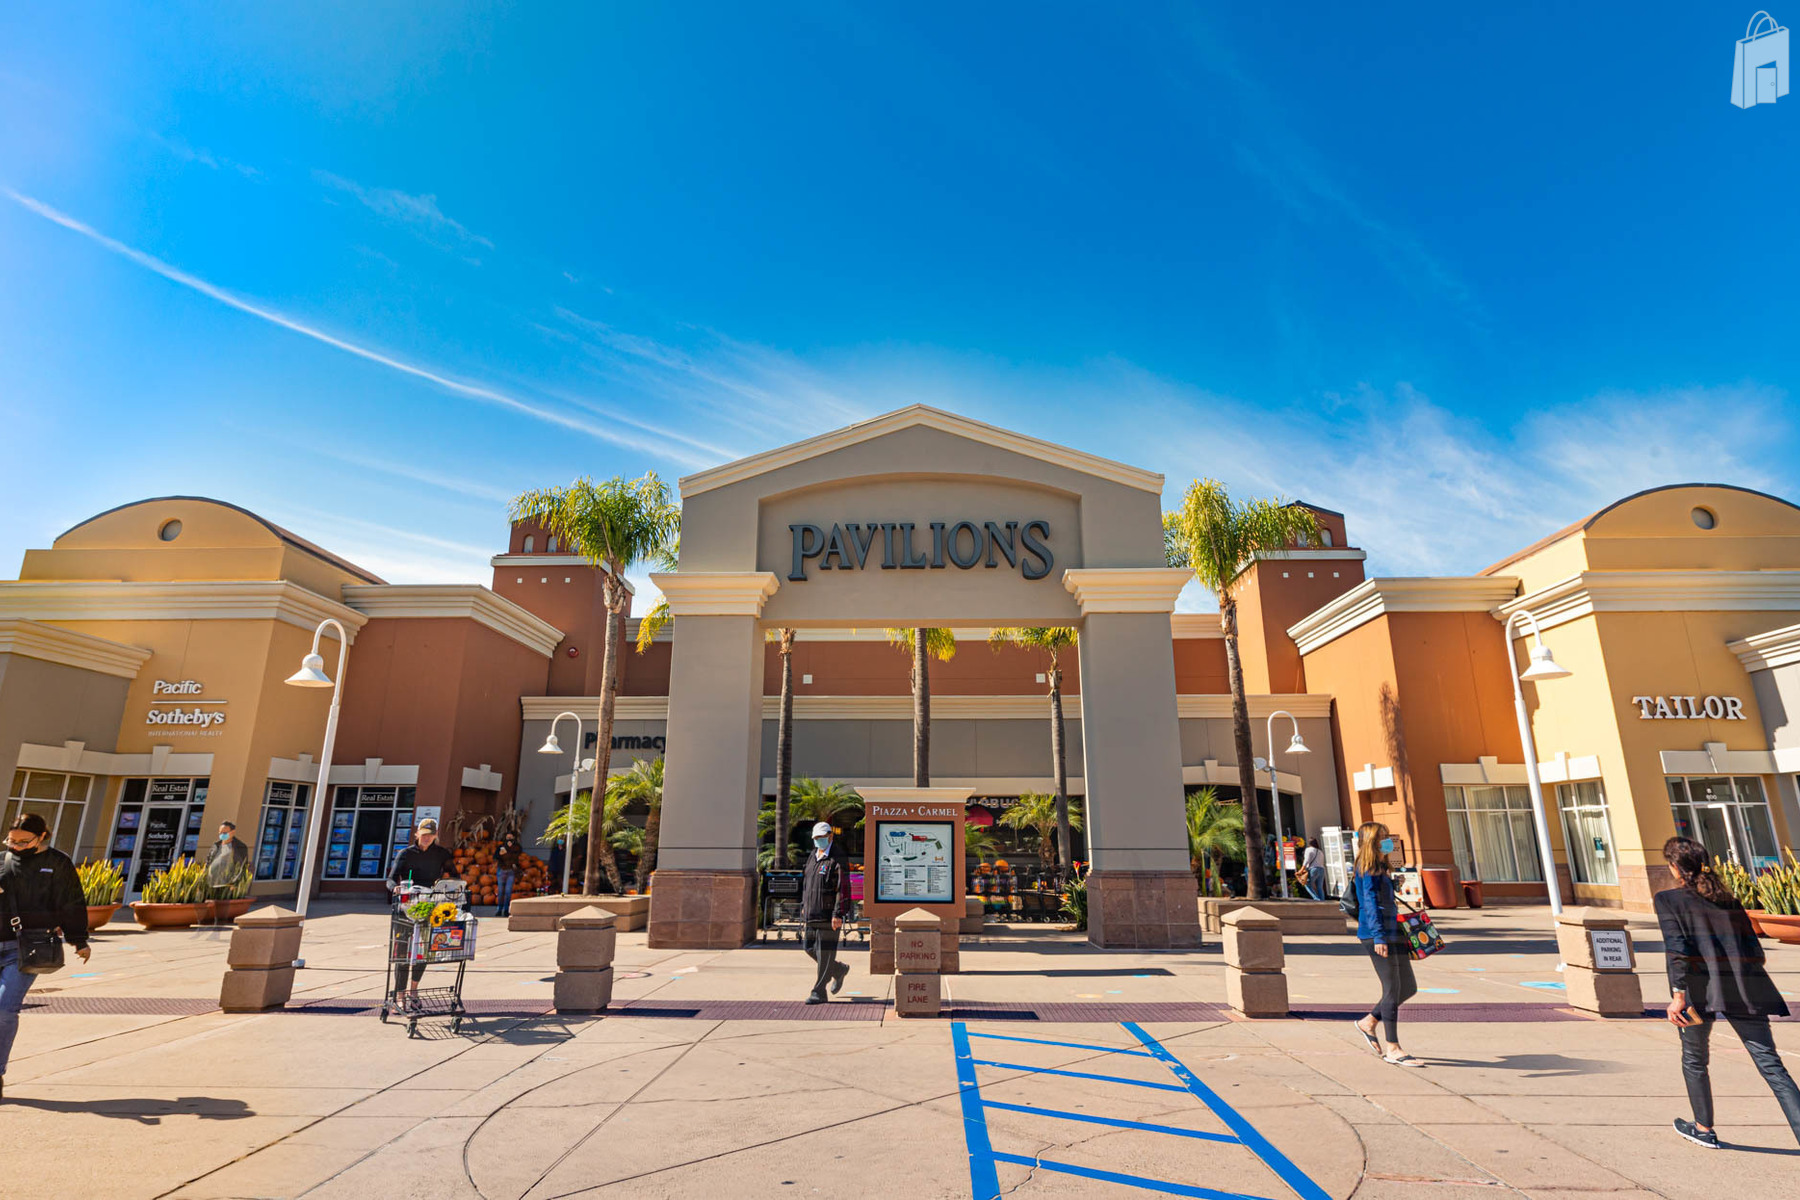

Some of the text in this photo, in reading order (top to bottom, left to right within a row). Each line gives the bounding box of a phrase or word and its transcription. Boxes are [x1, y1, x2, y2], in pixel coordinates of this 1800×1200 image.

[788, 520, 1054, 581] PAVILIONS
[153, 680, 203, 694] Pacific
[1632, 695, 1747, 720] TAILOR
[146, 708, 225, 728] Sotheby's
[376, 794, 394, 802] Estat
[872, 805, 958, 817] PIAZZA CARMEL
[910, 940, 924, 948] NO
[899, 952, 937, 960] PARKING
[908, 982, 927, 991] FIRE
[907, 995, 928, 1004] LANE
